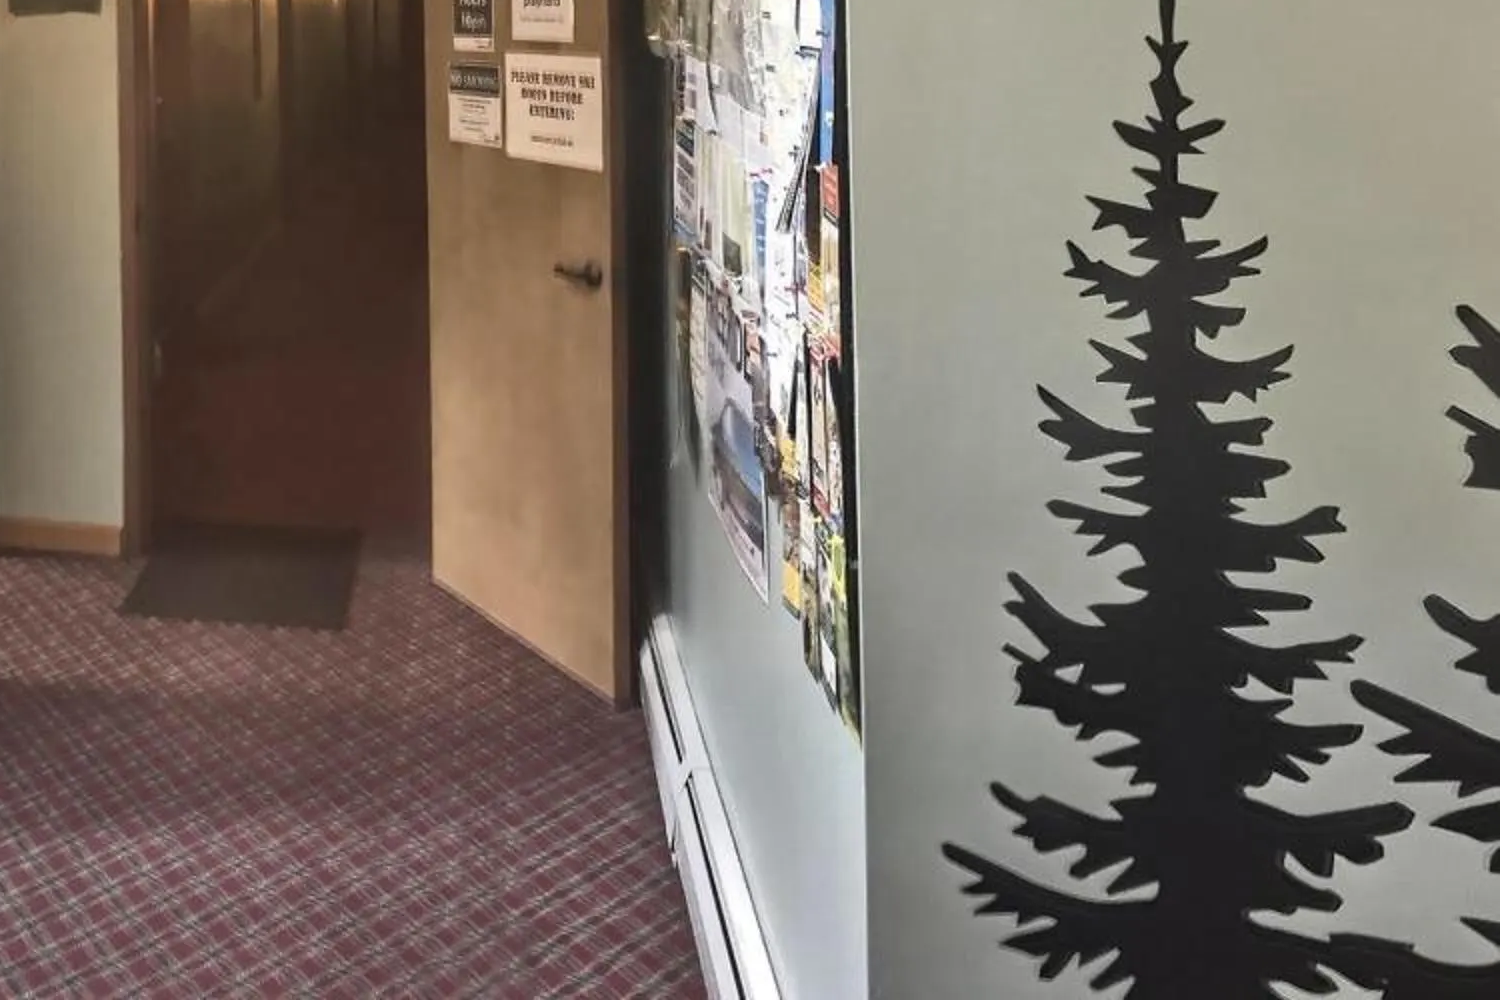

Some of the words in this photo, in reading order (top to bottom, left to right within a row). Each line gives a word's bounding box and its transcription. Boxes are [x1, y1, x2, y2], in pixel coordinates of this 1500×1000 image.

[511, 71, 540, 84] PLEASE
[542, 73, 576, 88] REMOVE
[521, 87, 547, 100] BOOTS
[549, 90, 584, 104] BEFORE
